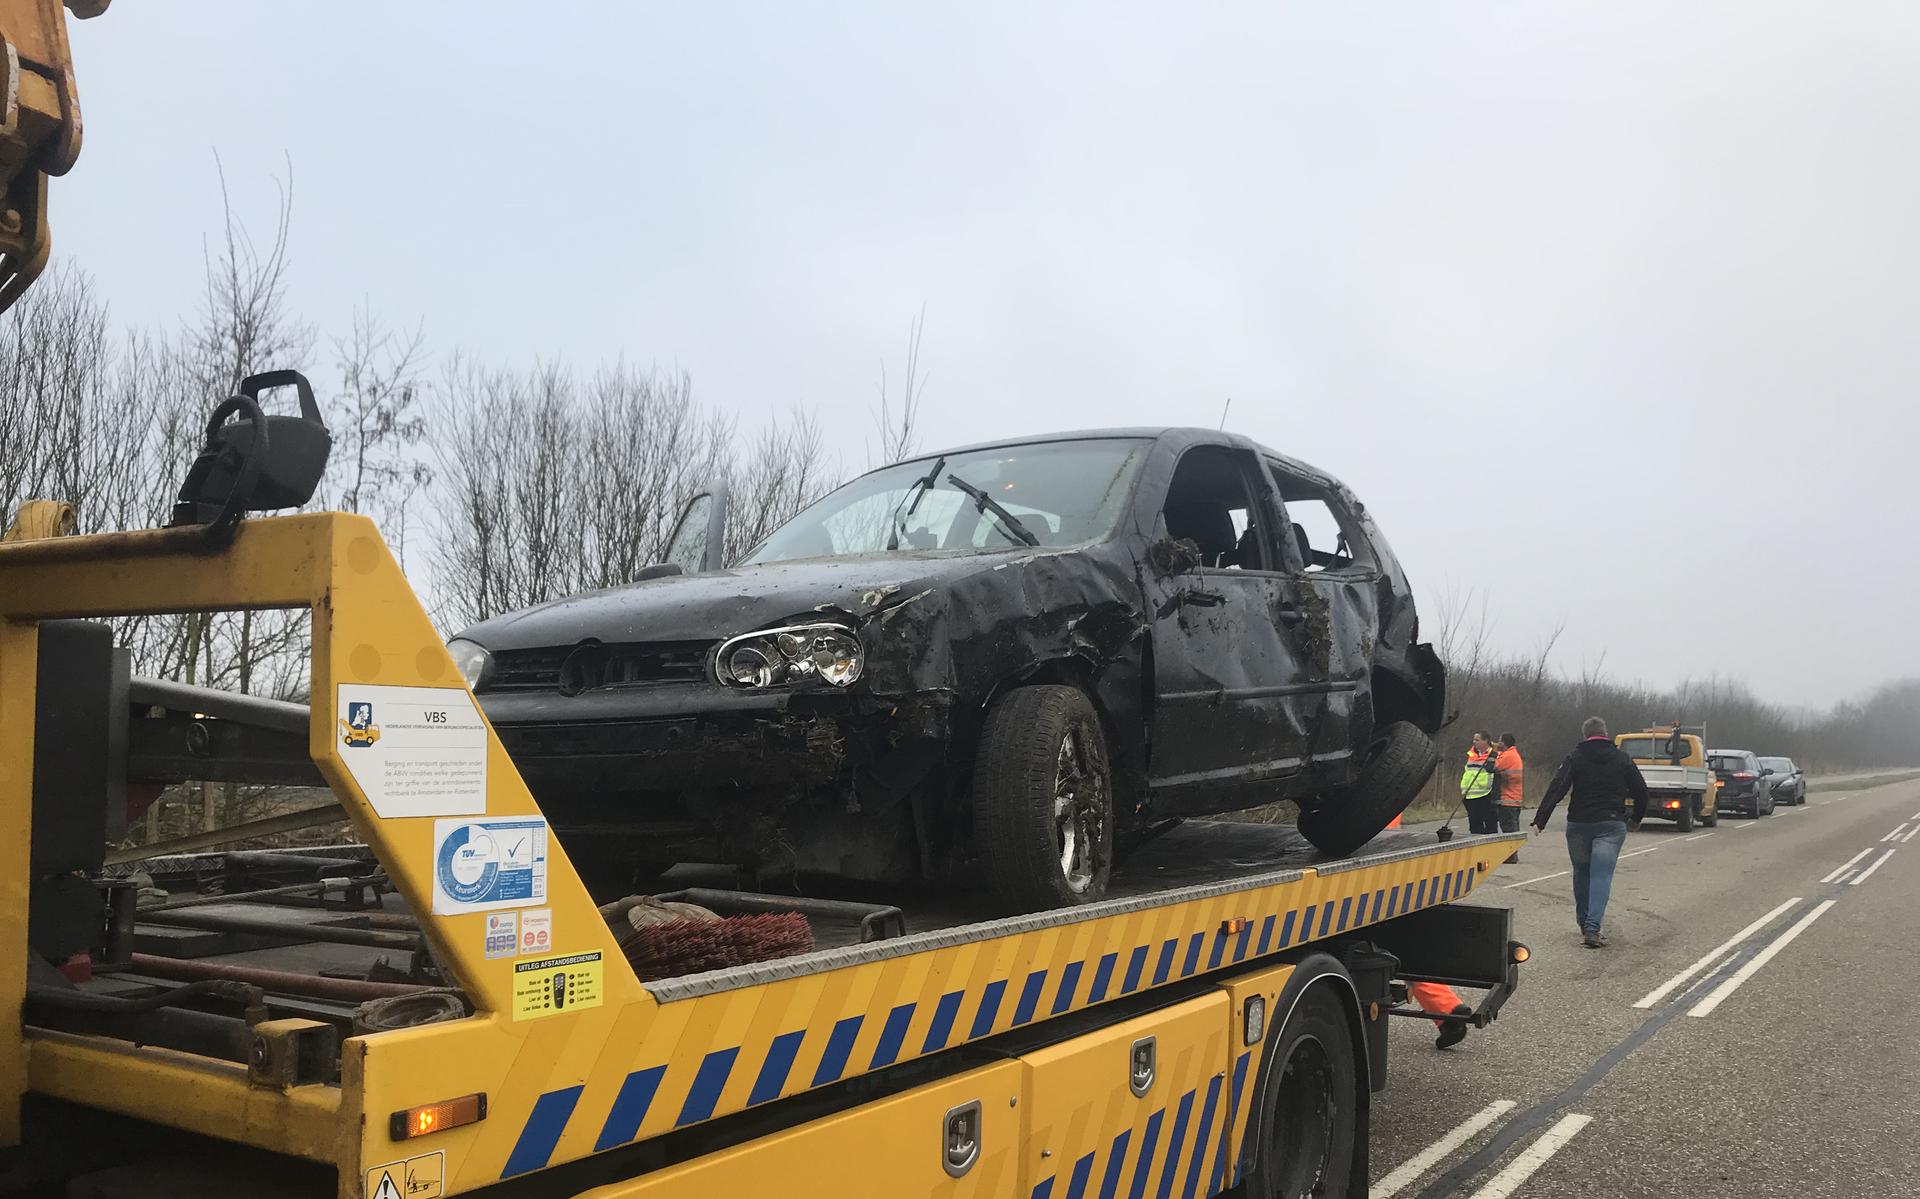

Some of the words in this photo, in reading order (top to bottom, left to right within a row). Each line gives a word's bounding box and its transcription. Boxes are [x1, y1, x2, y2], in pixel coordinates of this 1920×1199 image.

[424, 711, 447, 723] VBS
[462, 849, 475, 858] TÜV
[454, 882, 481, 894] Keurmerk
[518, 962, 540, 971] UITLEG
[540, 953, 599, 968] AFSTANDSBEDIENING
